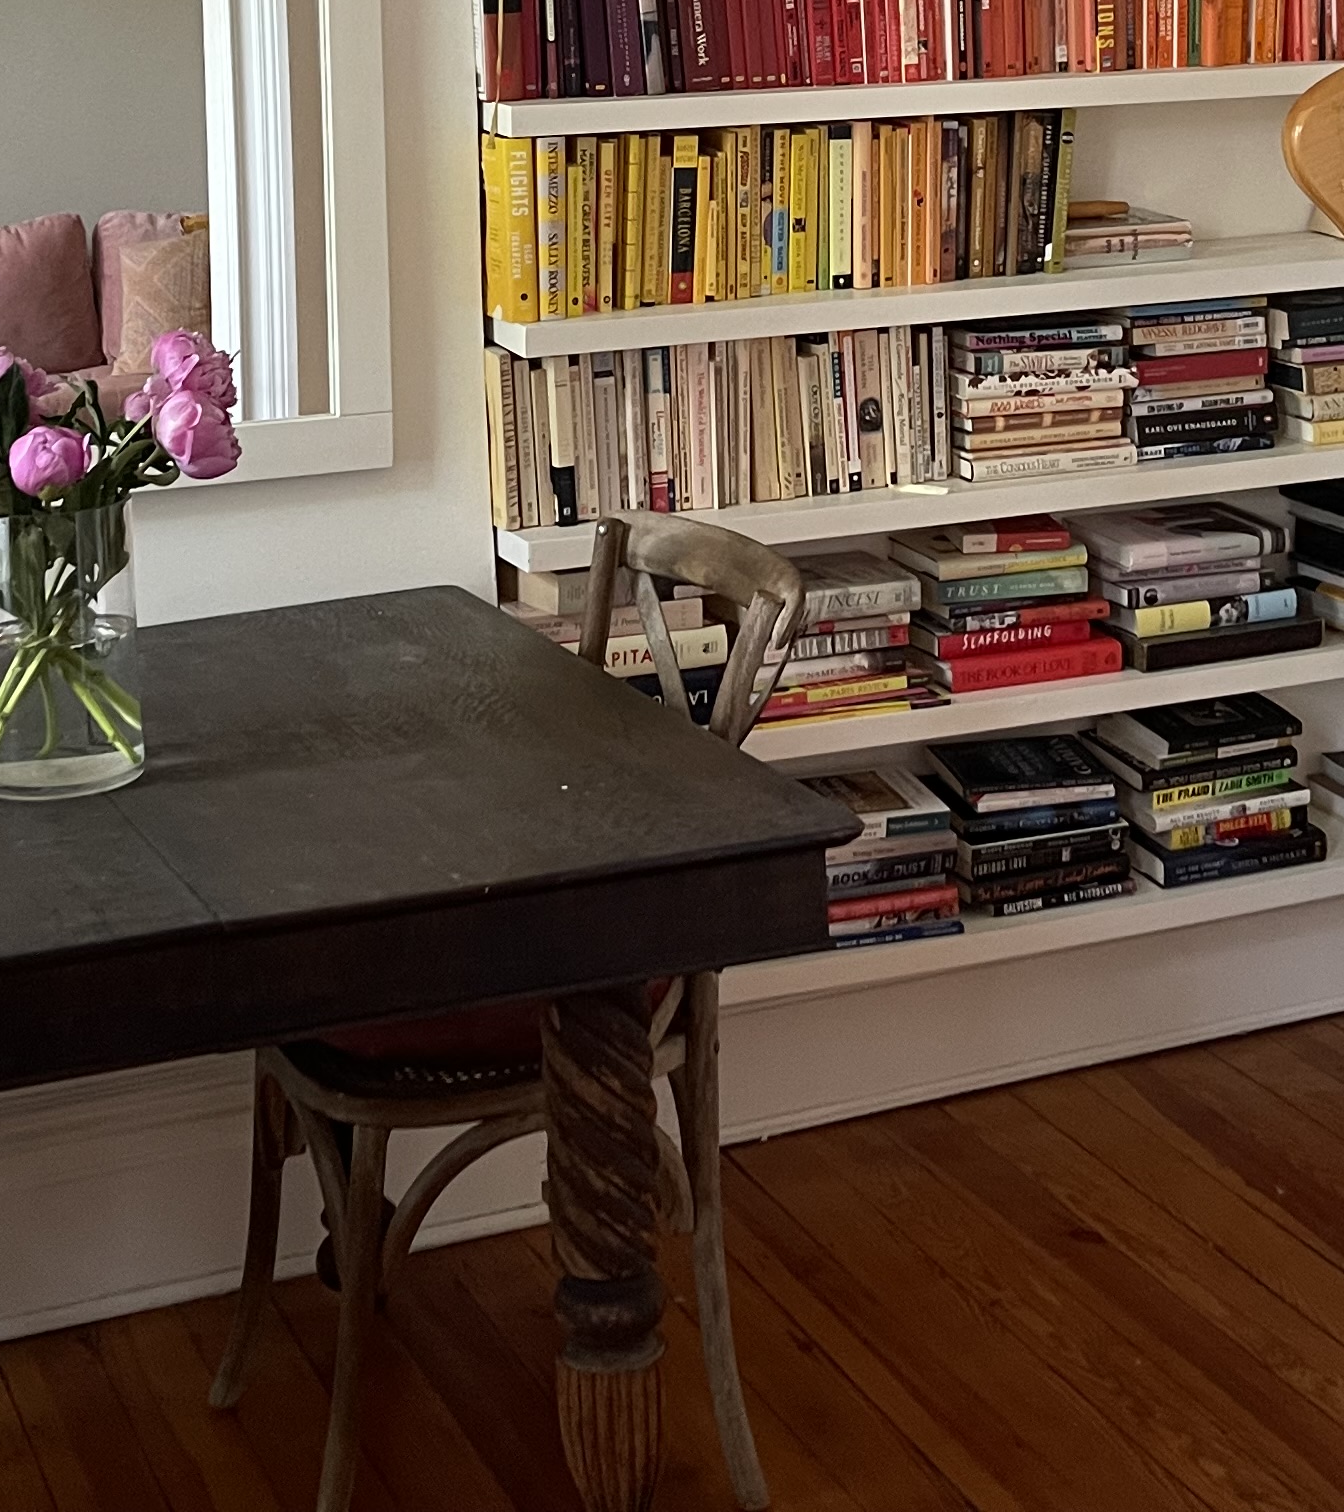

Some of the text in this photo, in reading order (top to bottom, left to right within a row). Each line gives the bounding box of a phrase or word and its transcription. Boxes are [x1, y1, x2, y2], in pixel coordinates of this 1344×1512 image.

[696, 33, 709, 66] Work
[510, 151, 529, 216] FLIGHTS
[548, 142, 559, 214] INTERMEZZO
[677, 188, 692, 253] BARCELONA
[548, 233, 559, 316] SALLY ROONEY
[975, 329, 1073, 346] Nothing Special
[1144, 425, 1165, 435] KARL
[1166, 423, 1182, 433] OVE
[826, 592, 880, 609] INCEST
[945, 582, 1002, 599] TRUST
[961, 624, 1053, 651] SCAFFOLDING
[832, 870, 868, 886] BOOK
